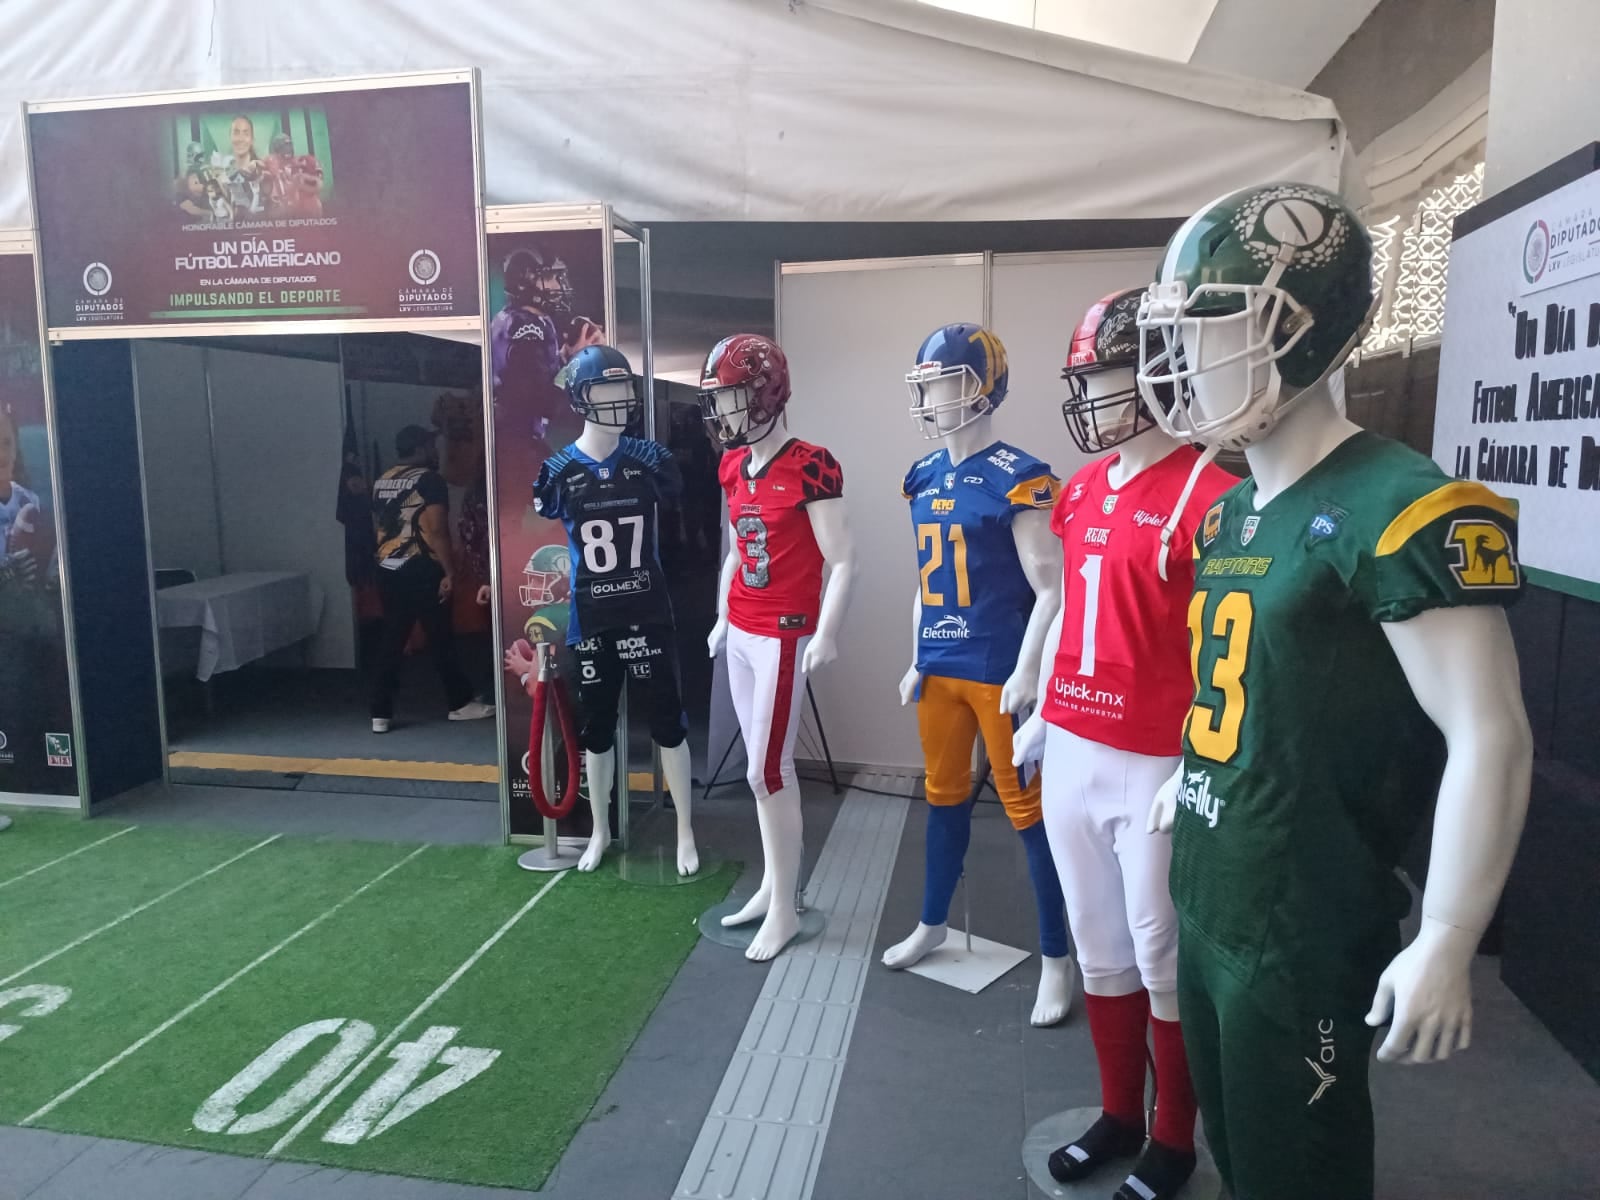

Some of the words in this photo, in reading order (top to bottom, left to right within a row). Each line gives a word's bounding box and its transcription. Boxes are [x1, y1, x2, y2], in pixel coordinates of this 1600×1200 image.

[182, 221, 235, 231] HONORABLE
[236, 219, 273, 229] CÁMARA
[275, 219, 287, 228] DE
[289, 217, 338, 226] DIPUTADOS
[213, 241, 237, 255] UN
[241, 237, 269, 253] DÍA
[273, 239, 295, 252] DE
[175, 253, 238, 270] FÚTBOL
[241, 251, 341, 268] AMERICANO
[200, 278, 211, 286] EN
[213, 277, 223, 286] LA
[225, 275, 259, 285] CÁMARA
[261, 276, 272, 284] DE
[273, 275, 317, 283] DIPUTADOS
[170, 292, 254, 307] IMPULSANDO
[259, 291, 275, 304] EL
[281, 289, 341, 304] DEPORTE
[399, 293, 453, 302] DIPUTADOS
[1587, 302, 1600, 348] D
[1547, 446, 1570, 488] DE
[1311, 516, 1335, 536] IPS
[581, 515, 644, 573] 87
[1084, 527, 1111, 545] REDS
[736, 516, 771, 589] 3
[918, 523, 971, 607] 21
[1202, 556, 1273, 576] RAPTORS
[593, 580, 639, 594] GOLMEX
[1077, 554, 1104, 677] 1
[922, 626, 971, 639] Electrolit
[616, 636, 648, 651] nox
[1181, 590, 1253, 764] 13
[1054, 677, 1125, 707] Upick.mx
[1054, 698, 1069, 708] CASA
[1070, 702, 1078, 711] DE
[192, 1017, 501, 1144] 40
